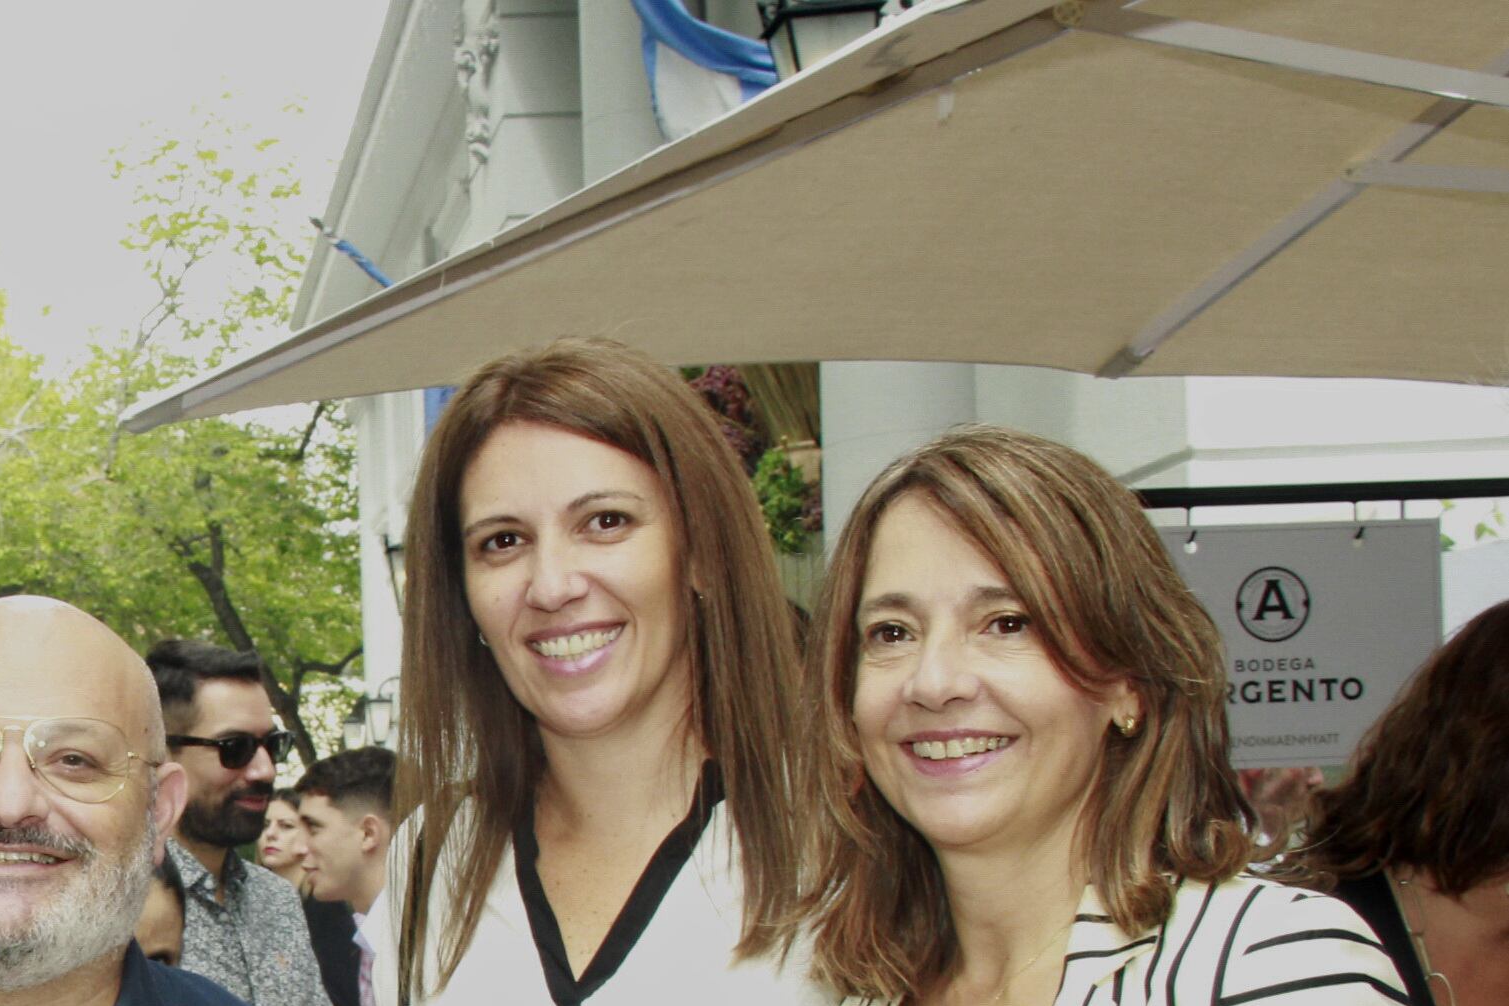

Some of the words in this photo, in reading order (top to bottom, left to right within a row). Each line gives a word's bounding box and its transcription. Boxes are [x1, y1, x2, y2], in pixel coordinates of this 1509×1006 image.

[1252, 579, 1295, 620] A
[1235, 658, 1315, 672] BODEGA
[1227, 677, 1364, 704] RGENTO
